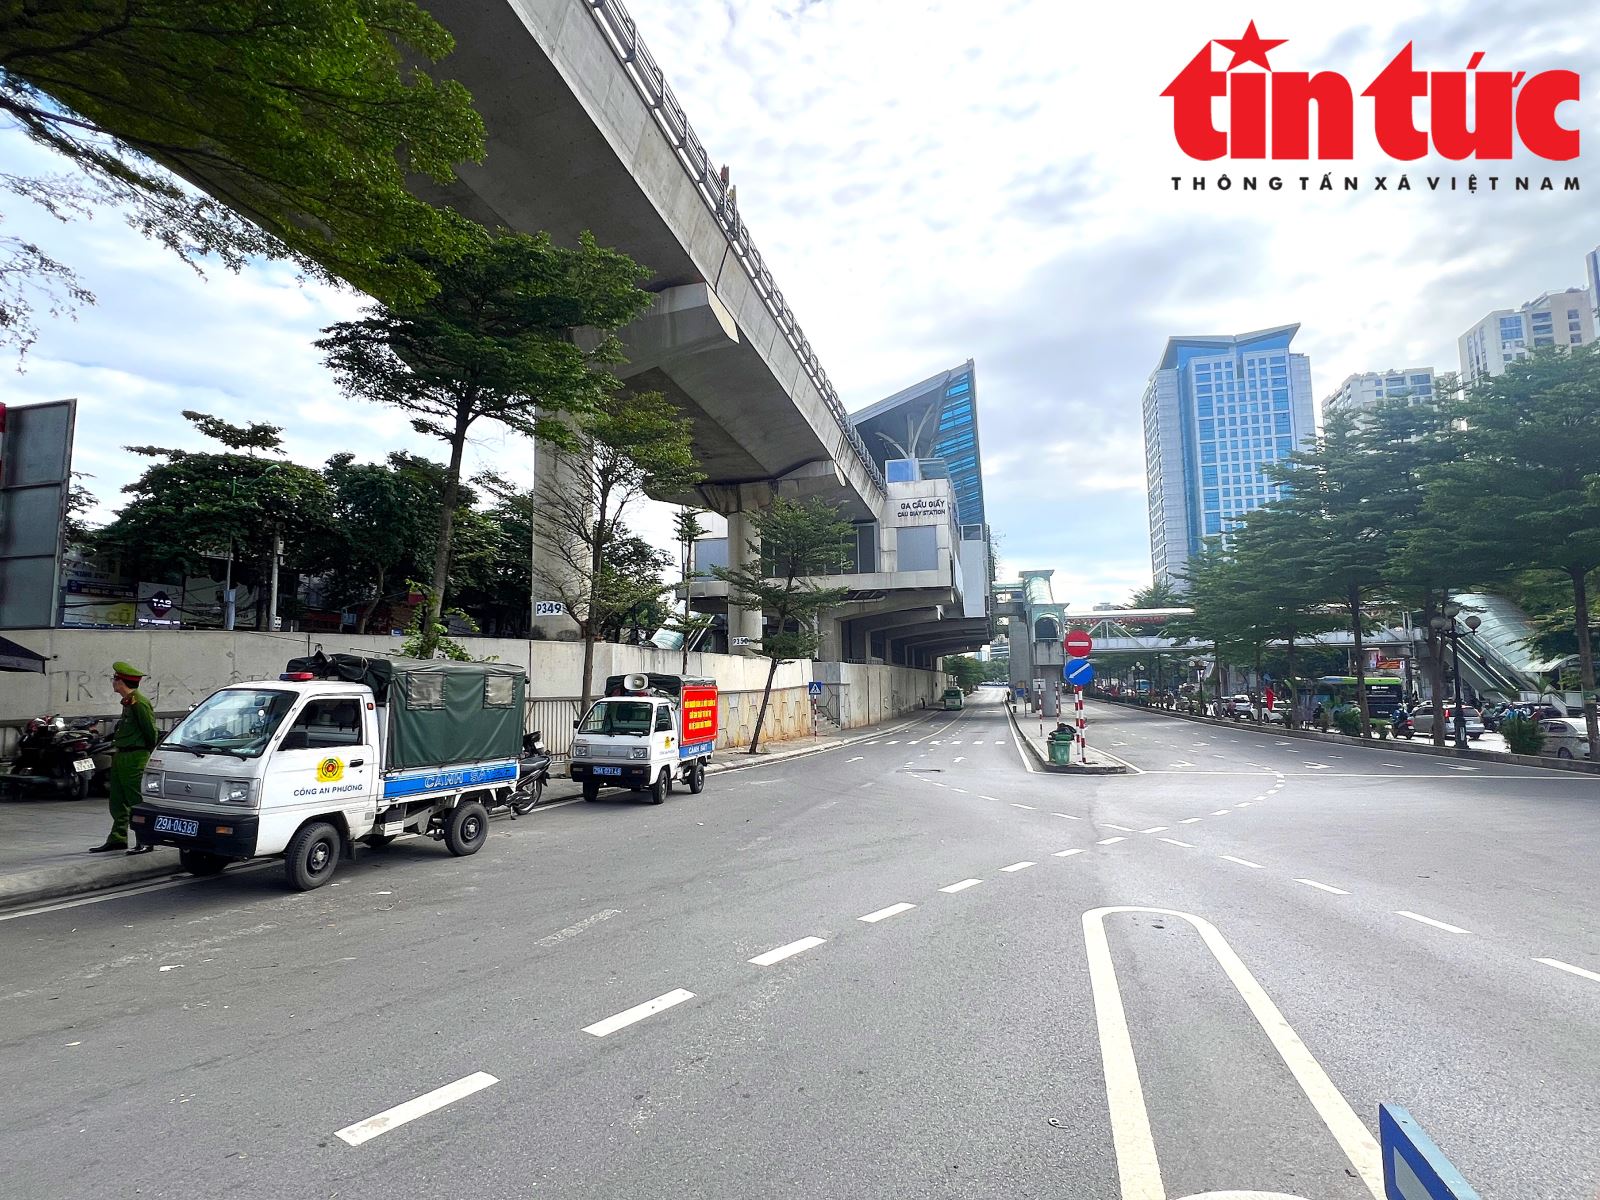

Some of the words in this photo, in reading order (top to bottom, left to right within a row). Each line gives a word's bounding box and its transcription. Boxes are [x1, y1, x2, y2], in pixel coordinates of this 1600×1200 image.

[900, 502, 911, 510] GA
[536, 601, 562, 614] P349
[293, 786, 317, 797] CÔNG
[318, 787, 331, 795] AN
